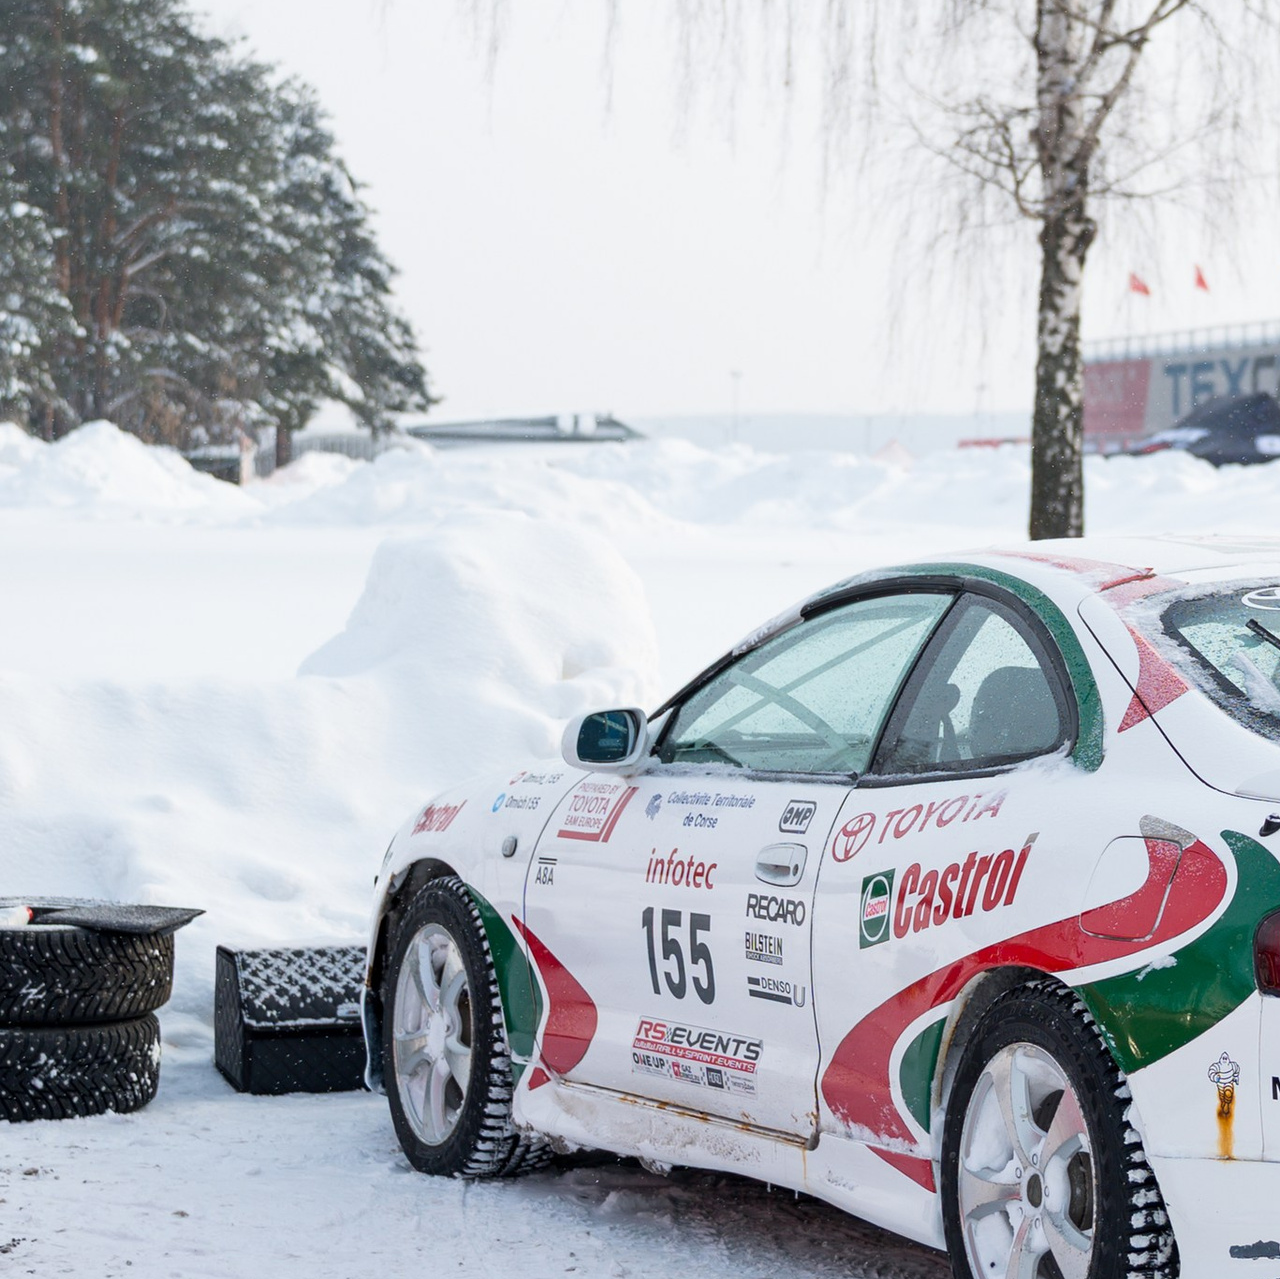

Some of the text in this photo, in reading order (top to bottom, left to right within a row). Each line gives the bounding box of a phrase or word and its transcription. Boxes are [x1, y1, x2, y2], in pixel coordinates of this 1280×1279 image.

[568, 794, 610, 816] TOYOTA
[782, 806, 813, 827] OMP
[878, 787, 1010, 844] TOYOTA
[682, 812, 719, 829] de Corse
[645, 847, 718, 890] infotec
[893, 832, 1040, 939] Castrol
[745, 893, 806, 926] RECARO
[865, 897, 888, 918] Castrol
[642, 906, 716, 1005] 155
[745, 932, 783, 957] BILSTEIN
[760, 977, 792, 995] DENSO
[636, 1020, 762, 1061] RS EVENTS
